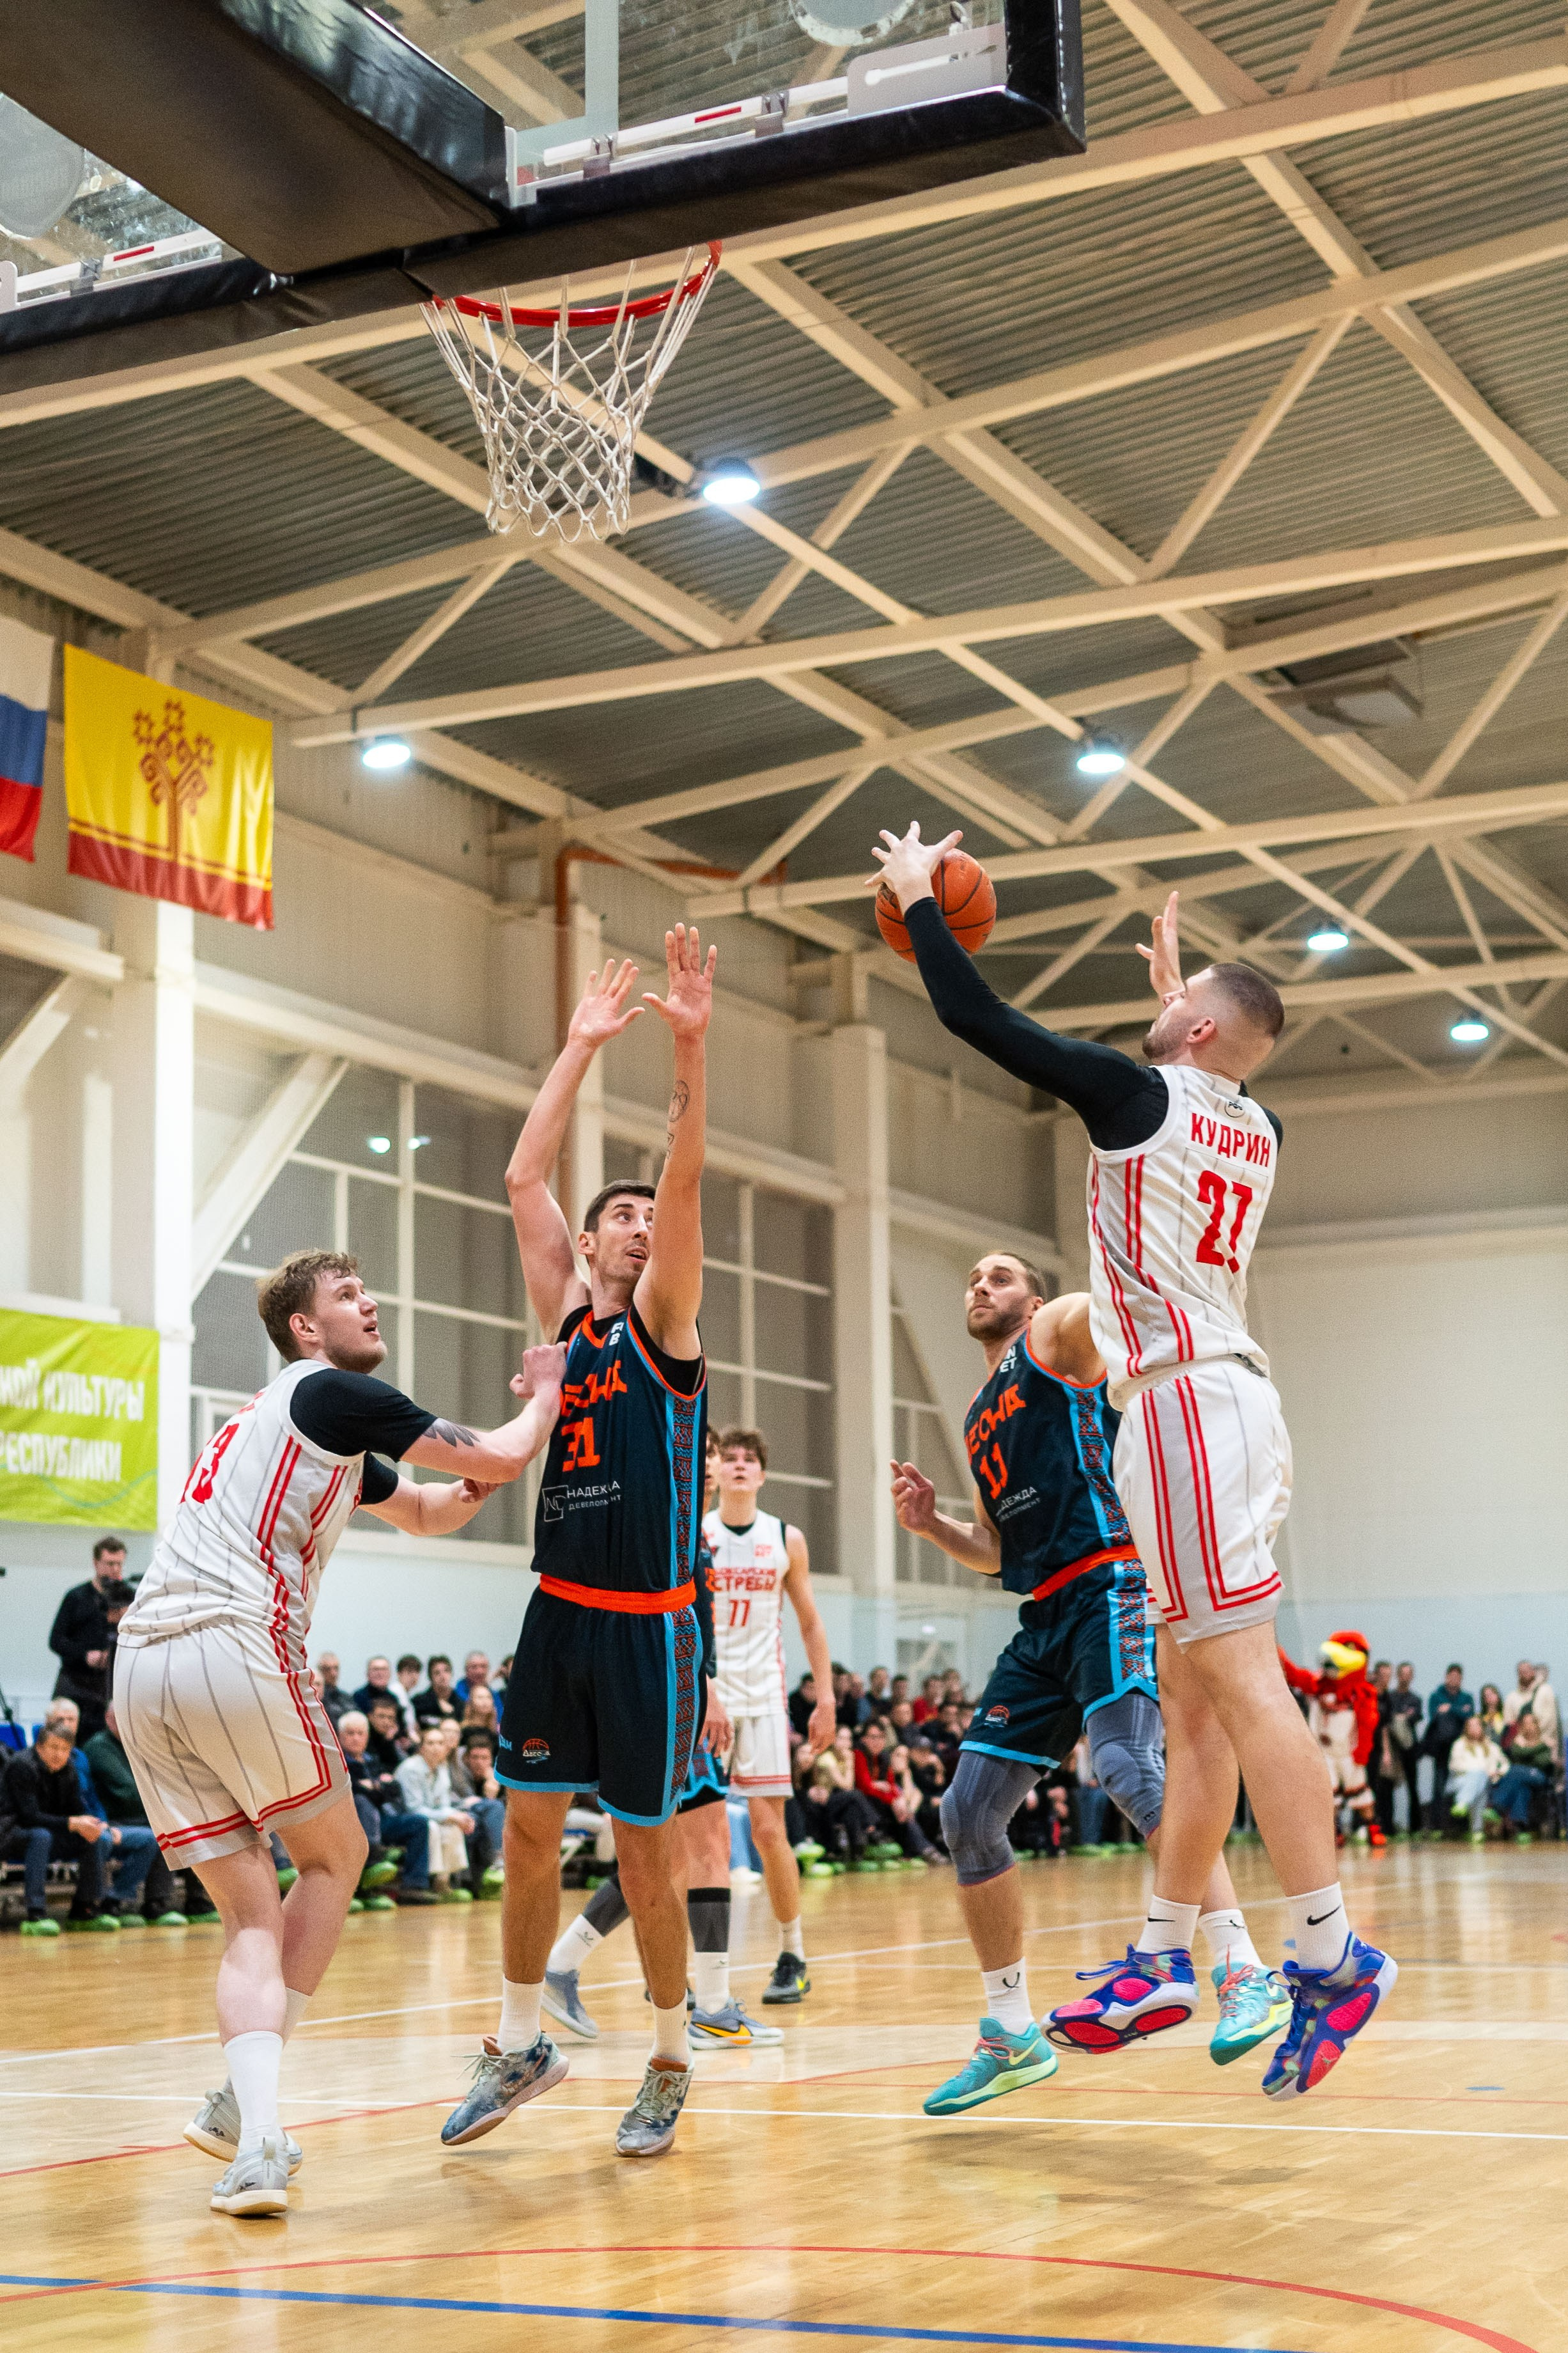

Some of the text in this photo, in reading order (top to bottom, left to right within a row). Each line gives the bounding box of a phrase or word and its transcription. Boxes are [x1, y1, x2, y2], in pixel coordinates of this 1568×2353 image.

[1191, 1112, 1271, 1168] КУДРИН
[1195, 1170, 1253, 1274] 27
[1000, 1357, 1017, 1373] ET
[567, 1480, 621, 1498] НАДЕЖА
[713, 1575, 777, 1591] СТРЕБЫ
[729, 1599, 751, 1627] 77
